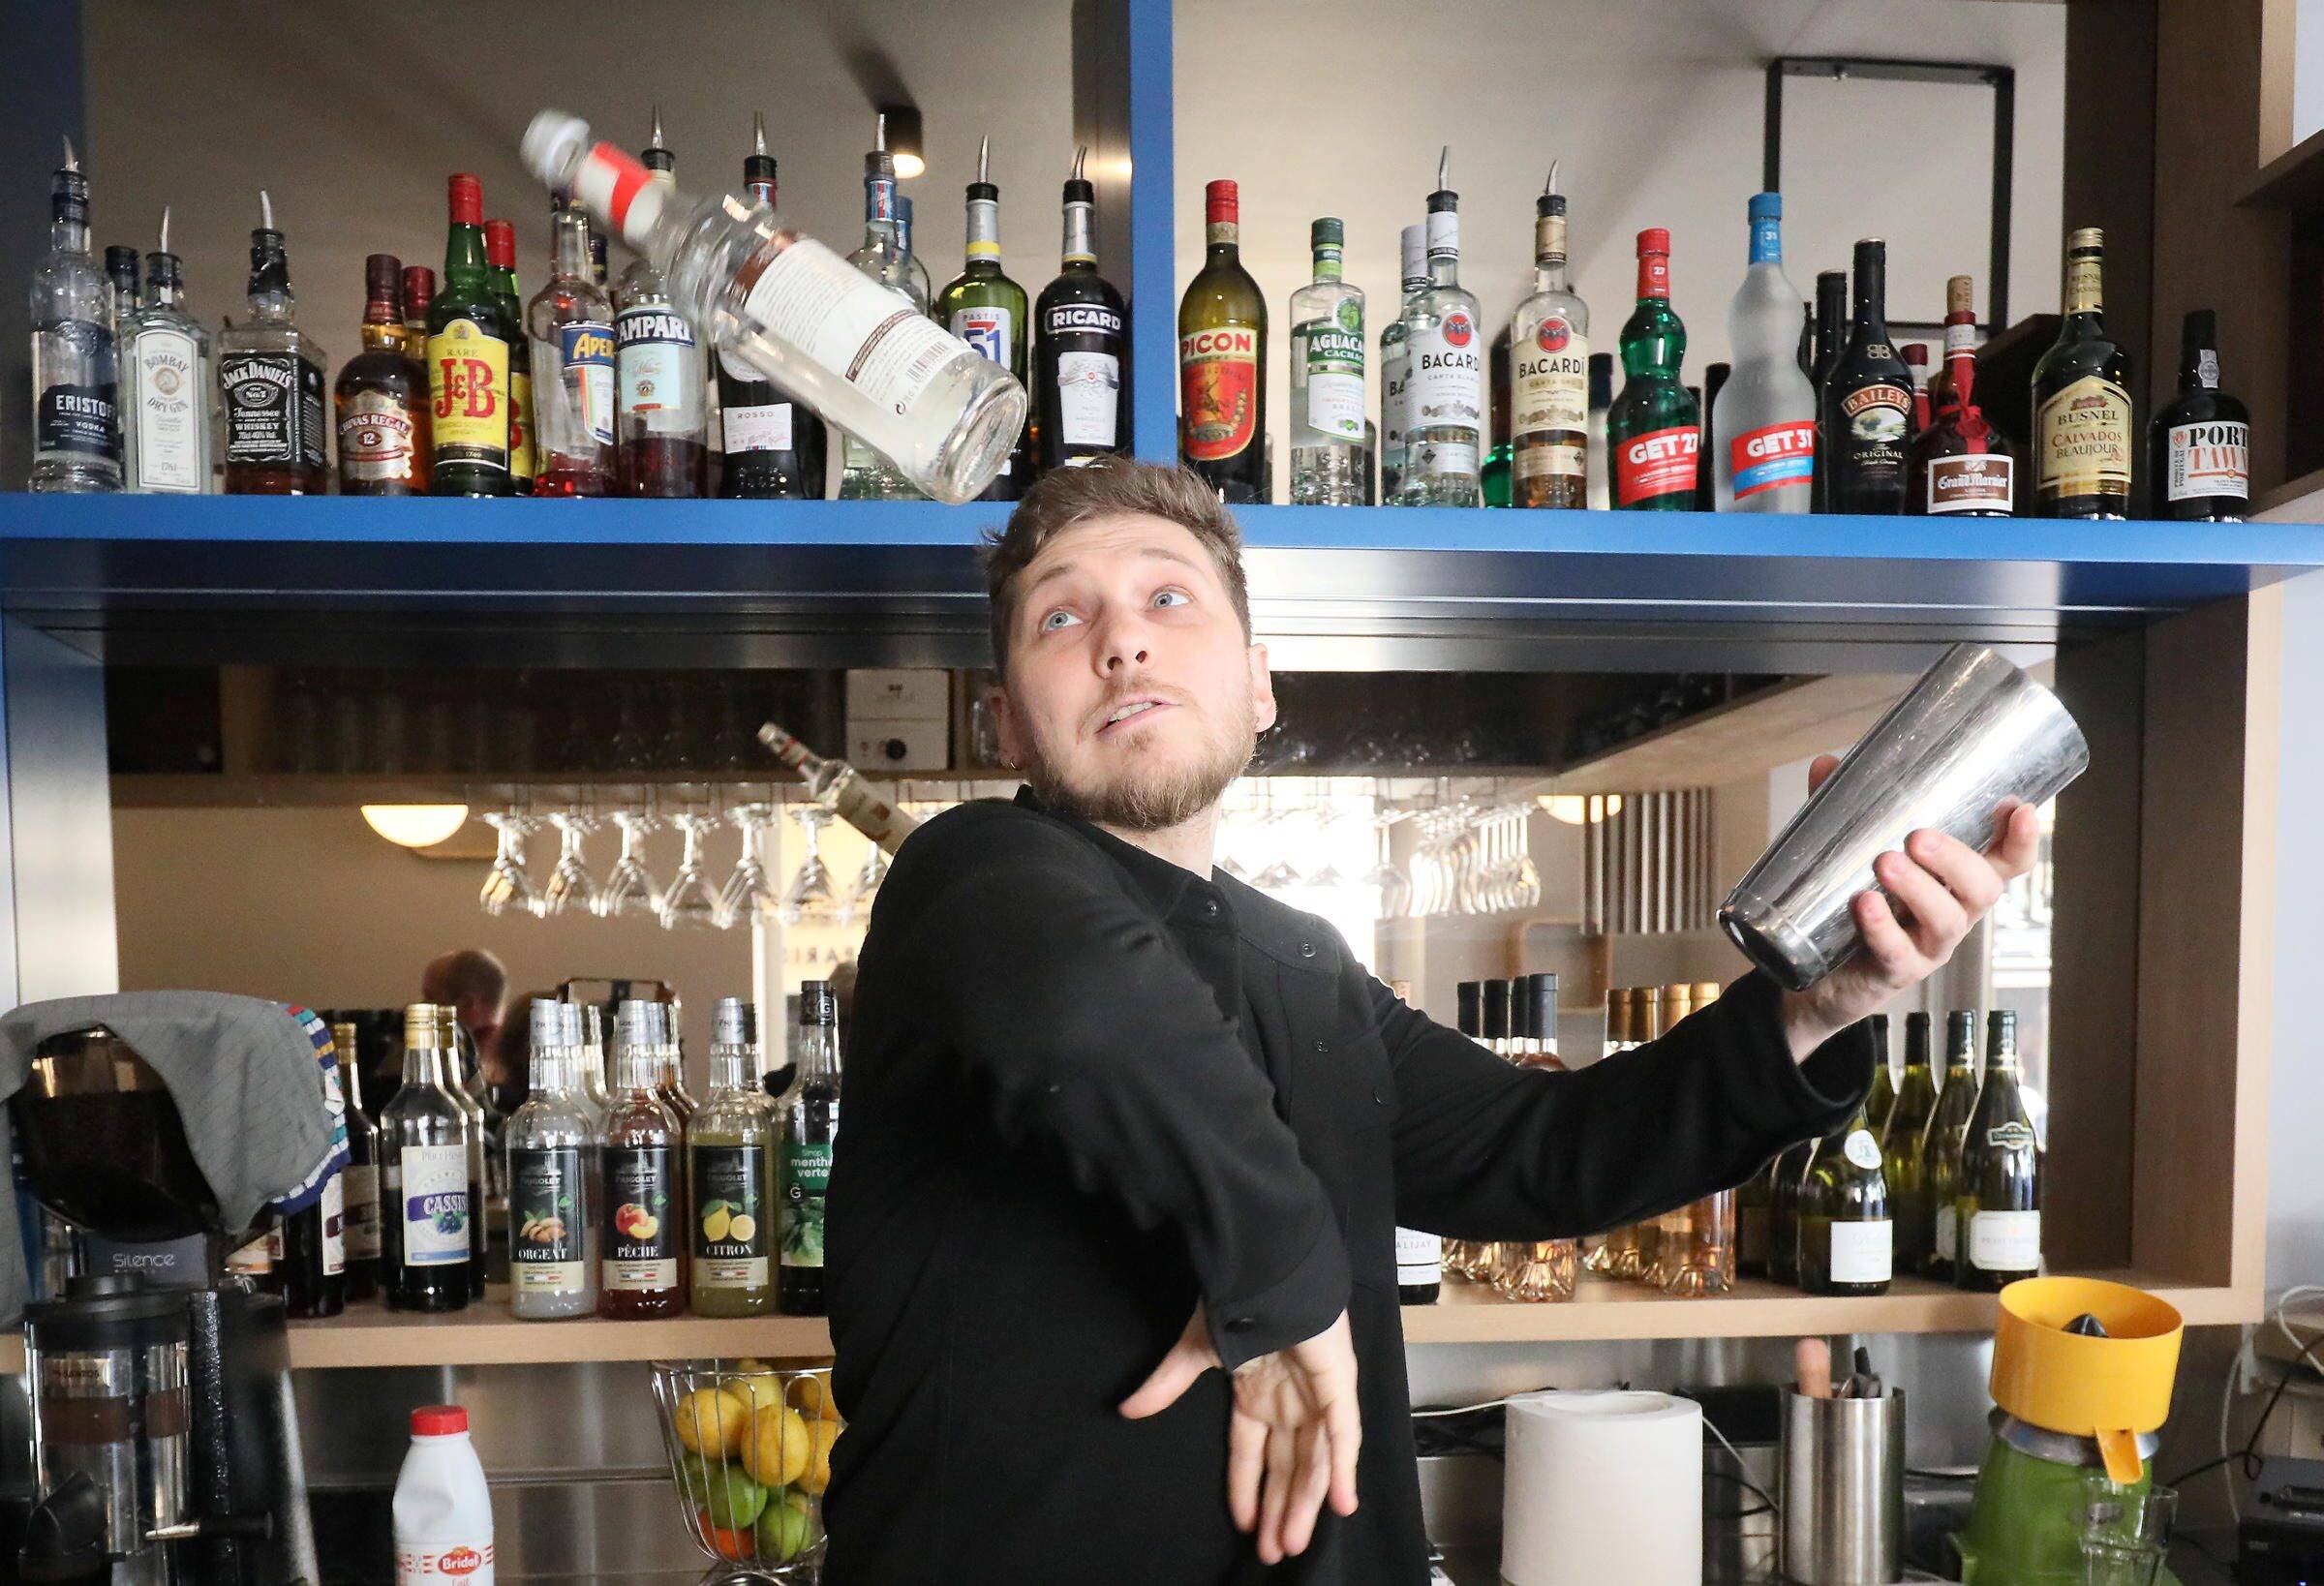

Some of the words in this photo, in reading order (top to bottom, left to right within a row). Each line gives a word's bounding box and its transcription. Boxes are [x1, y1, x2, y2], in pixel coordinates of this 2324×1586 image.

[963, 313, 1000, 321] PASTIS
[1053, 311, 1122, 331] RICARD
[618, 315, 691, 344] AMPARI
[572, 332, 615, 359] APER
[1180, 332, 1251, 356] PICON
[1310, 333, 1363, 352] AGUACA
[446, 349, 478, 357] RARE
[143, 353, 189, 373] BOMBAY
[1422, 351, 1479, 372] BACARD
[223, 366, 250, 389] JACK
[434, 357, 495, 419] J&B
[55, 394, 115, 419] ERISTOF
[1848, 389, 1910, 410] BAILEYS
[737, 411, 775, 419] ROSSO
[2058, 410, 2119, 425] BUSNEL
[76, 421, 106, 434] VODKA
[235, 422, 279, 431] WHISKEY
[371, 414, 408, 434] REGAL
[363, 432, 376, 444] 12
[1747, 430, 1794, 457] GET
[1796, 429, 1813, 448] 31
[2052, 431, 2123, 447] CALVADOS
[1629, 434, 1679, 465] GET
[1680, 433, 1698, 454] 27
[1853, 450, 1904, 460] ORIGINAL
[2056, 443, 2118, 459] BEAUJOUR
[2187, 446, 2248, 469] TAW
[797, 1168, 830, 1178] verte
[789, 1186, 802, 1199] G
[423, 1194, 467, 1215] CASSIS
[617, 1243, 659, 1258] PÊCHE
[706, 1244, 752, 1257] CITRON
[1395, 1239, 1432, 1249] ALIJAY
[112, 1253, 175, 1267] Silence
[442, 1554, 478, 1570] Bridel
